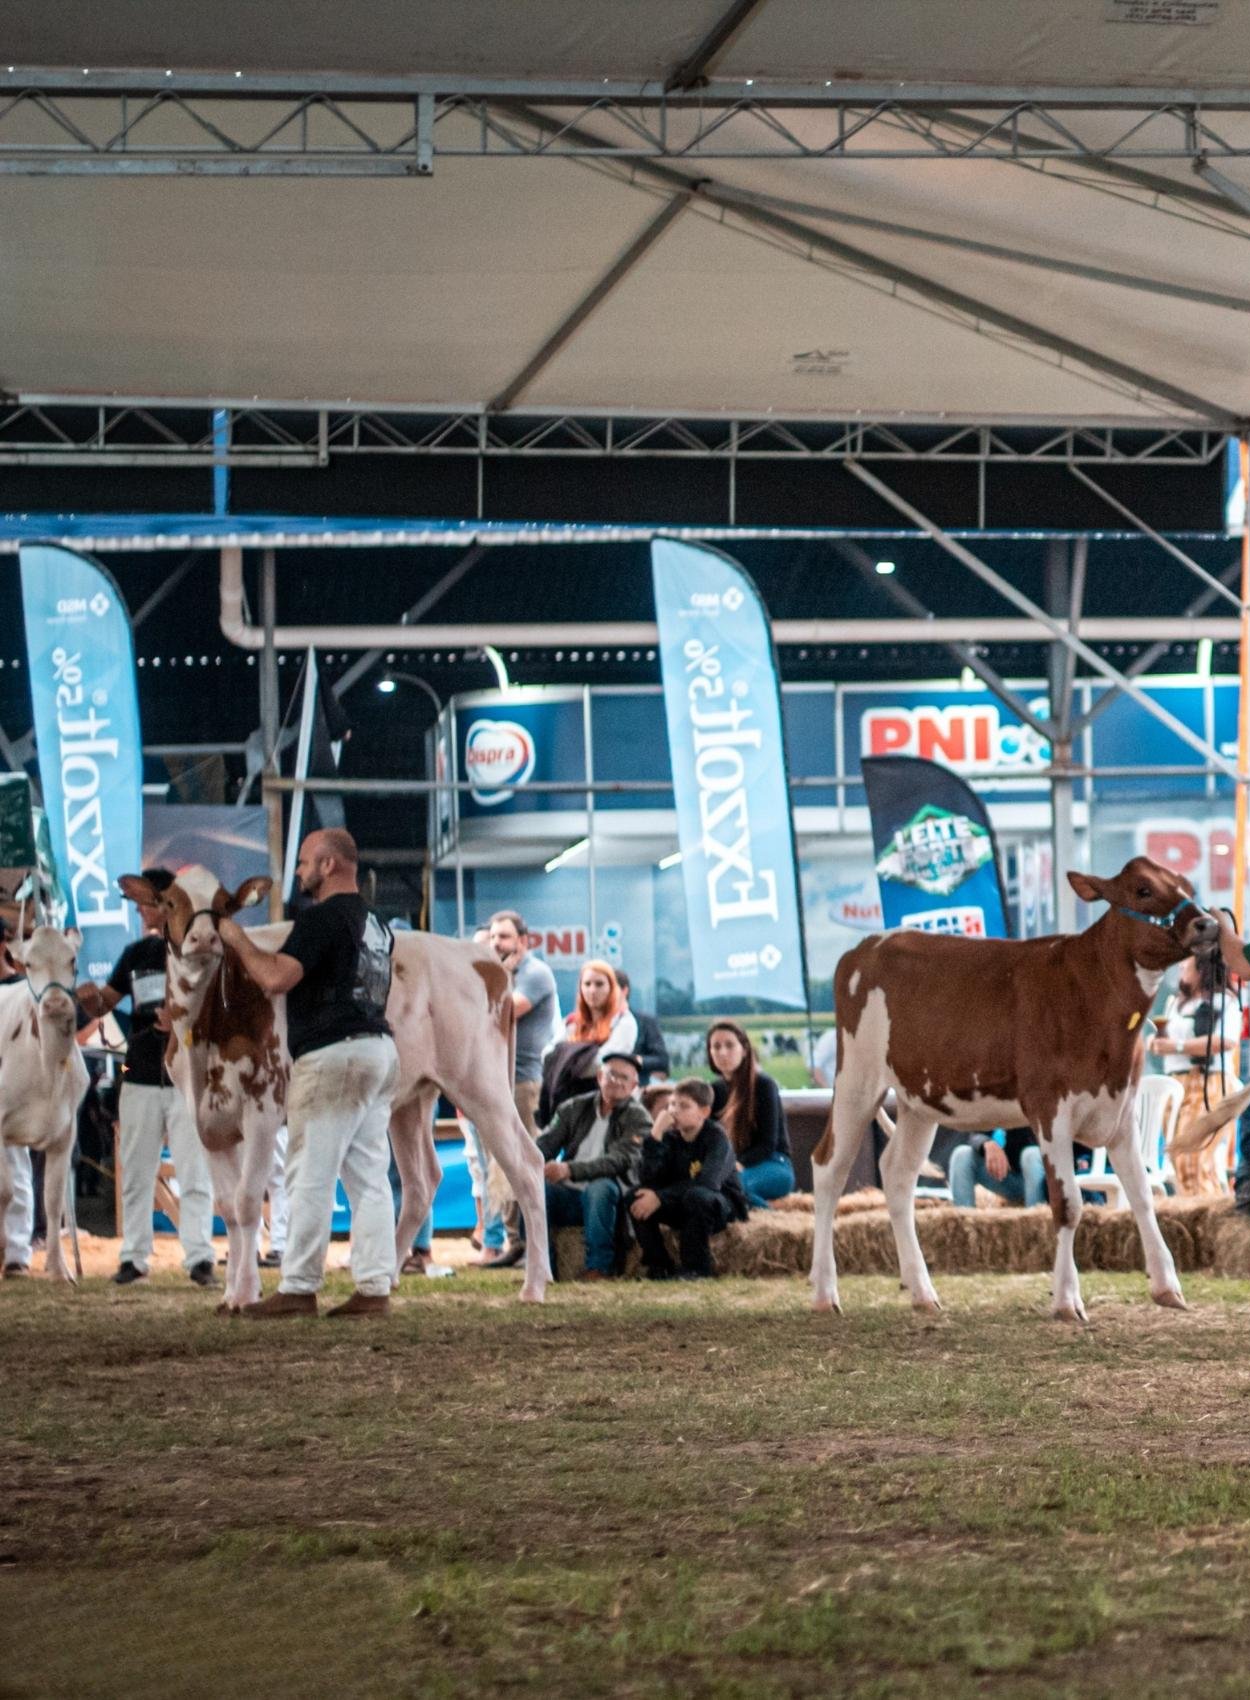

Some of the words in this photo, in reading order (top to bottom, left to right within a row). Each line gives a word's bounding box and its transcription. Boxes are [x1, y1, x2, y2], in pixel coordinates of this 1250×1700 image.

[869, 717, 991, 762] PNI
[894, 816, 971, 852] LEITE
[522, 930, 586, 955] PNI
